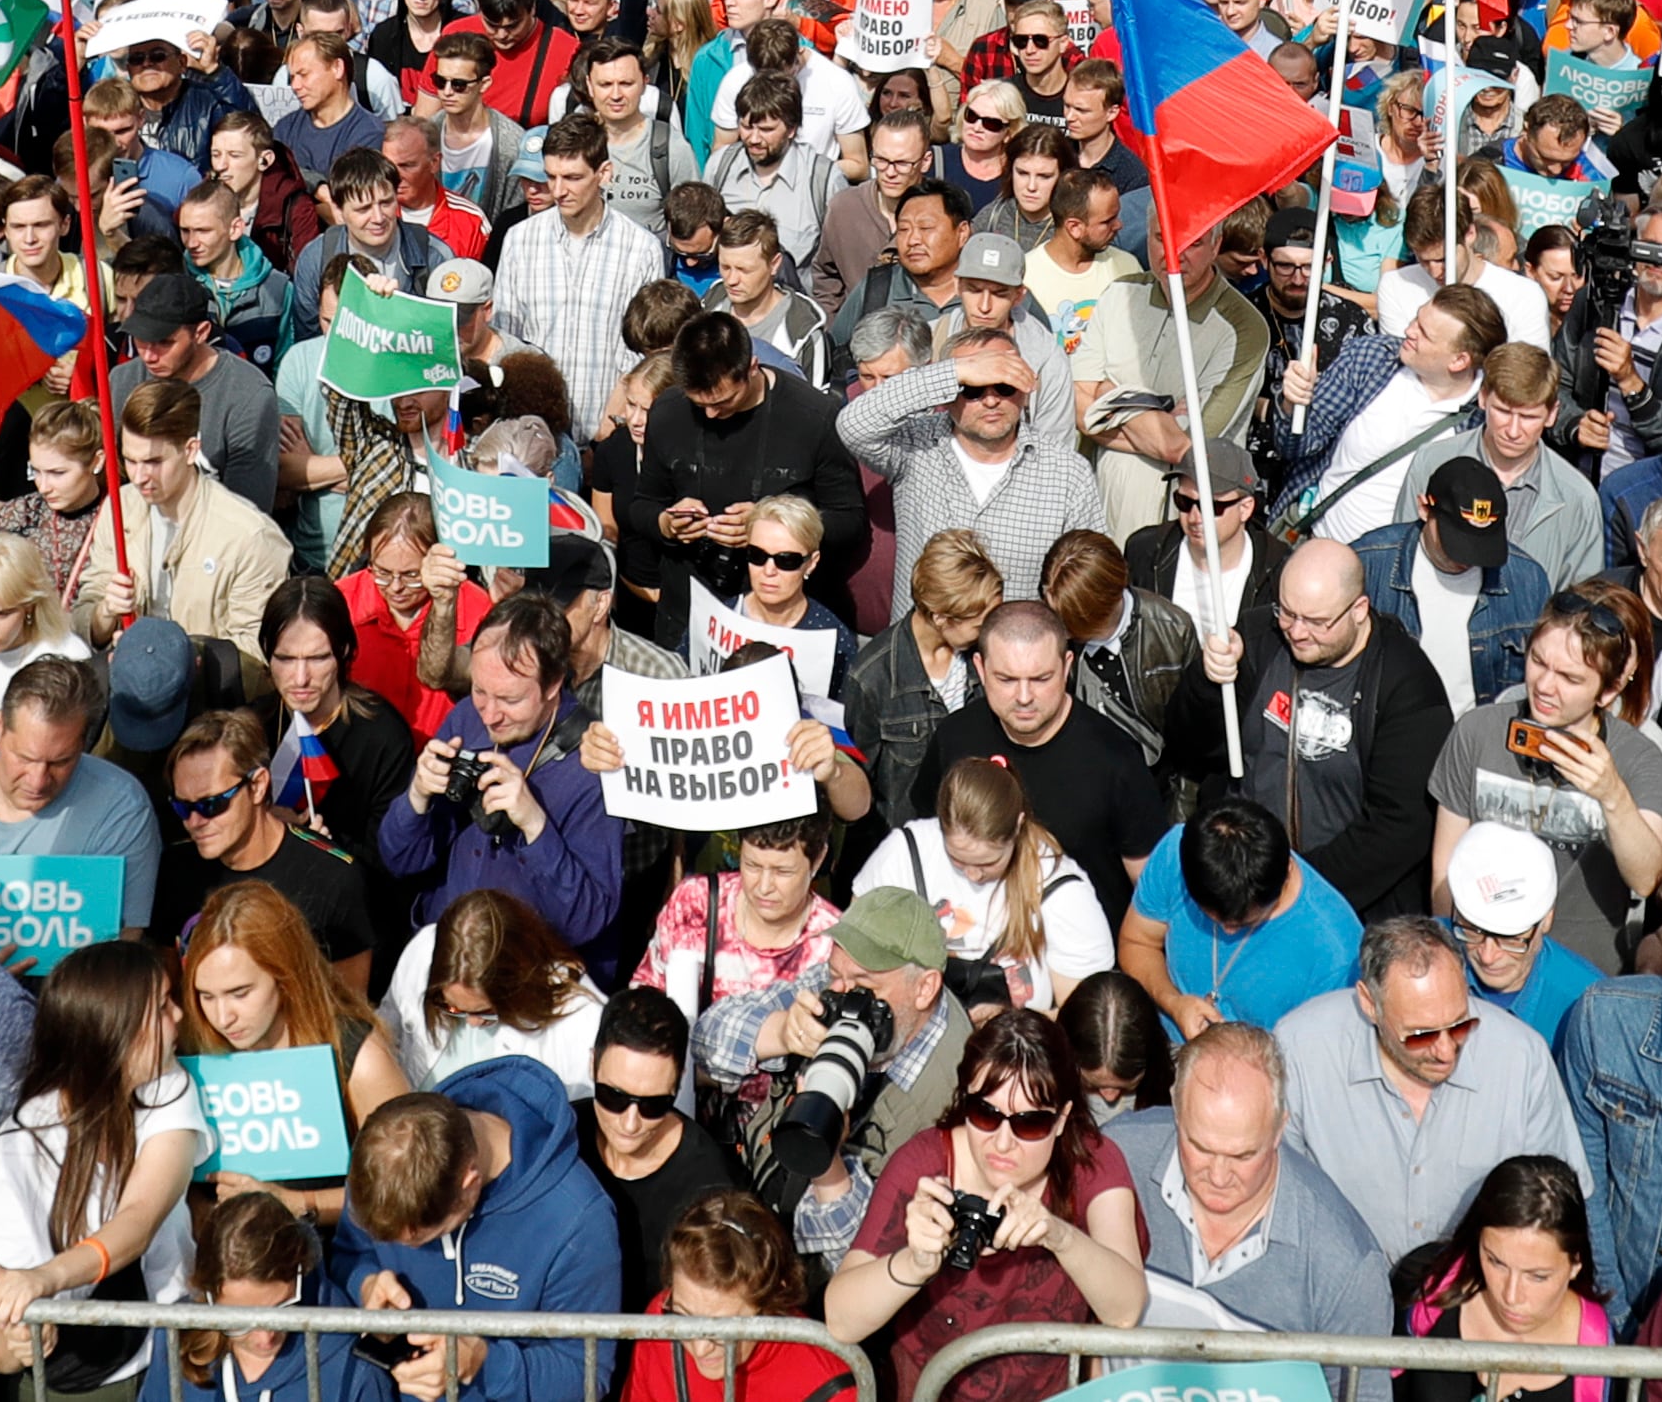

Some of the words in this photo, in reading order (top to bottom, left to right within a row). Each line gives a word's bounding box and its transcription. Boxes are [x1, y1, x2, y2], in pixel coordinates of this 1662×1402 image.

[1068, 26, 1097, 43] АВО
[1559, 65, 1650, 93] ЛЮБОВЬ
[1510, 186, 1579, 211] ЛЮБО
[335, 306, 435, 356] ДОПУСКАЙ!
[439, 512, 524, 548] БОЛЬ
[637, 700, 656, 729] Я
[662, 690, 761, 731] ИМЕЮ
[650, 730, 754, 765] ПРАВО
[624, 762, 665, 797] НА
[669, 757, 792, 802] ВЫБОР!
[204, 1080, 301, 1117] БОВЬ
[220, 1114, 320, 1156] БОЛЬ
